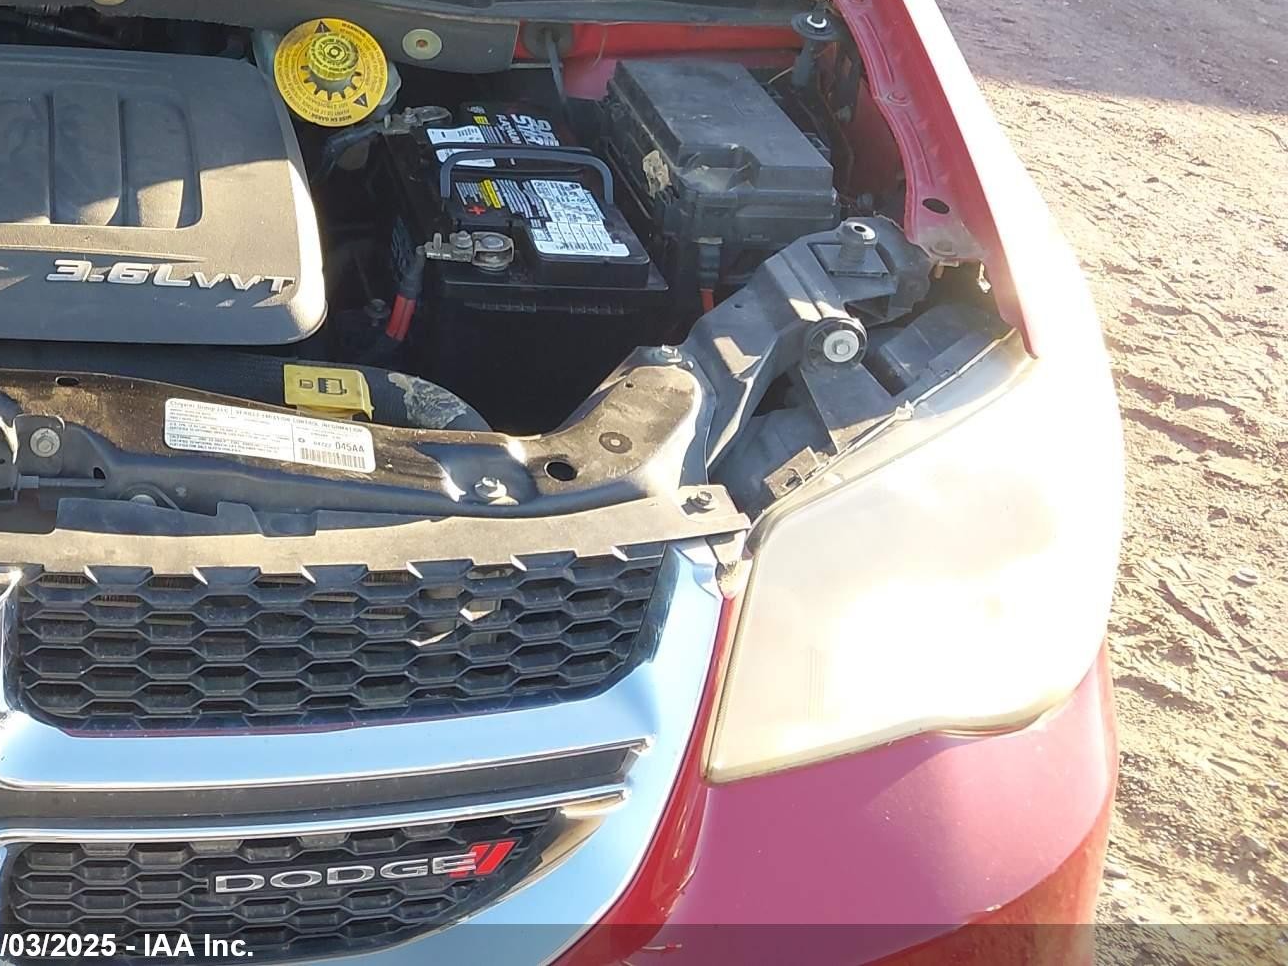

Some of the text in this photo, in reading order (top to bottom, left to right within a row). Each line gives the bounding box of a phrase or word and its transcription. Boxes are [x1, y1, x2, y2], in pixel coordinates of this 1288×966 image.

[46, 259, 296, 294] 3.6L VVT
[215, 851, 477, 894] DODGE
